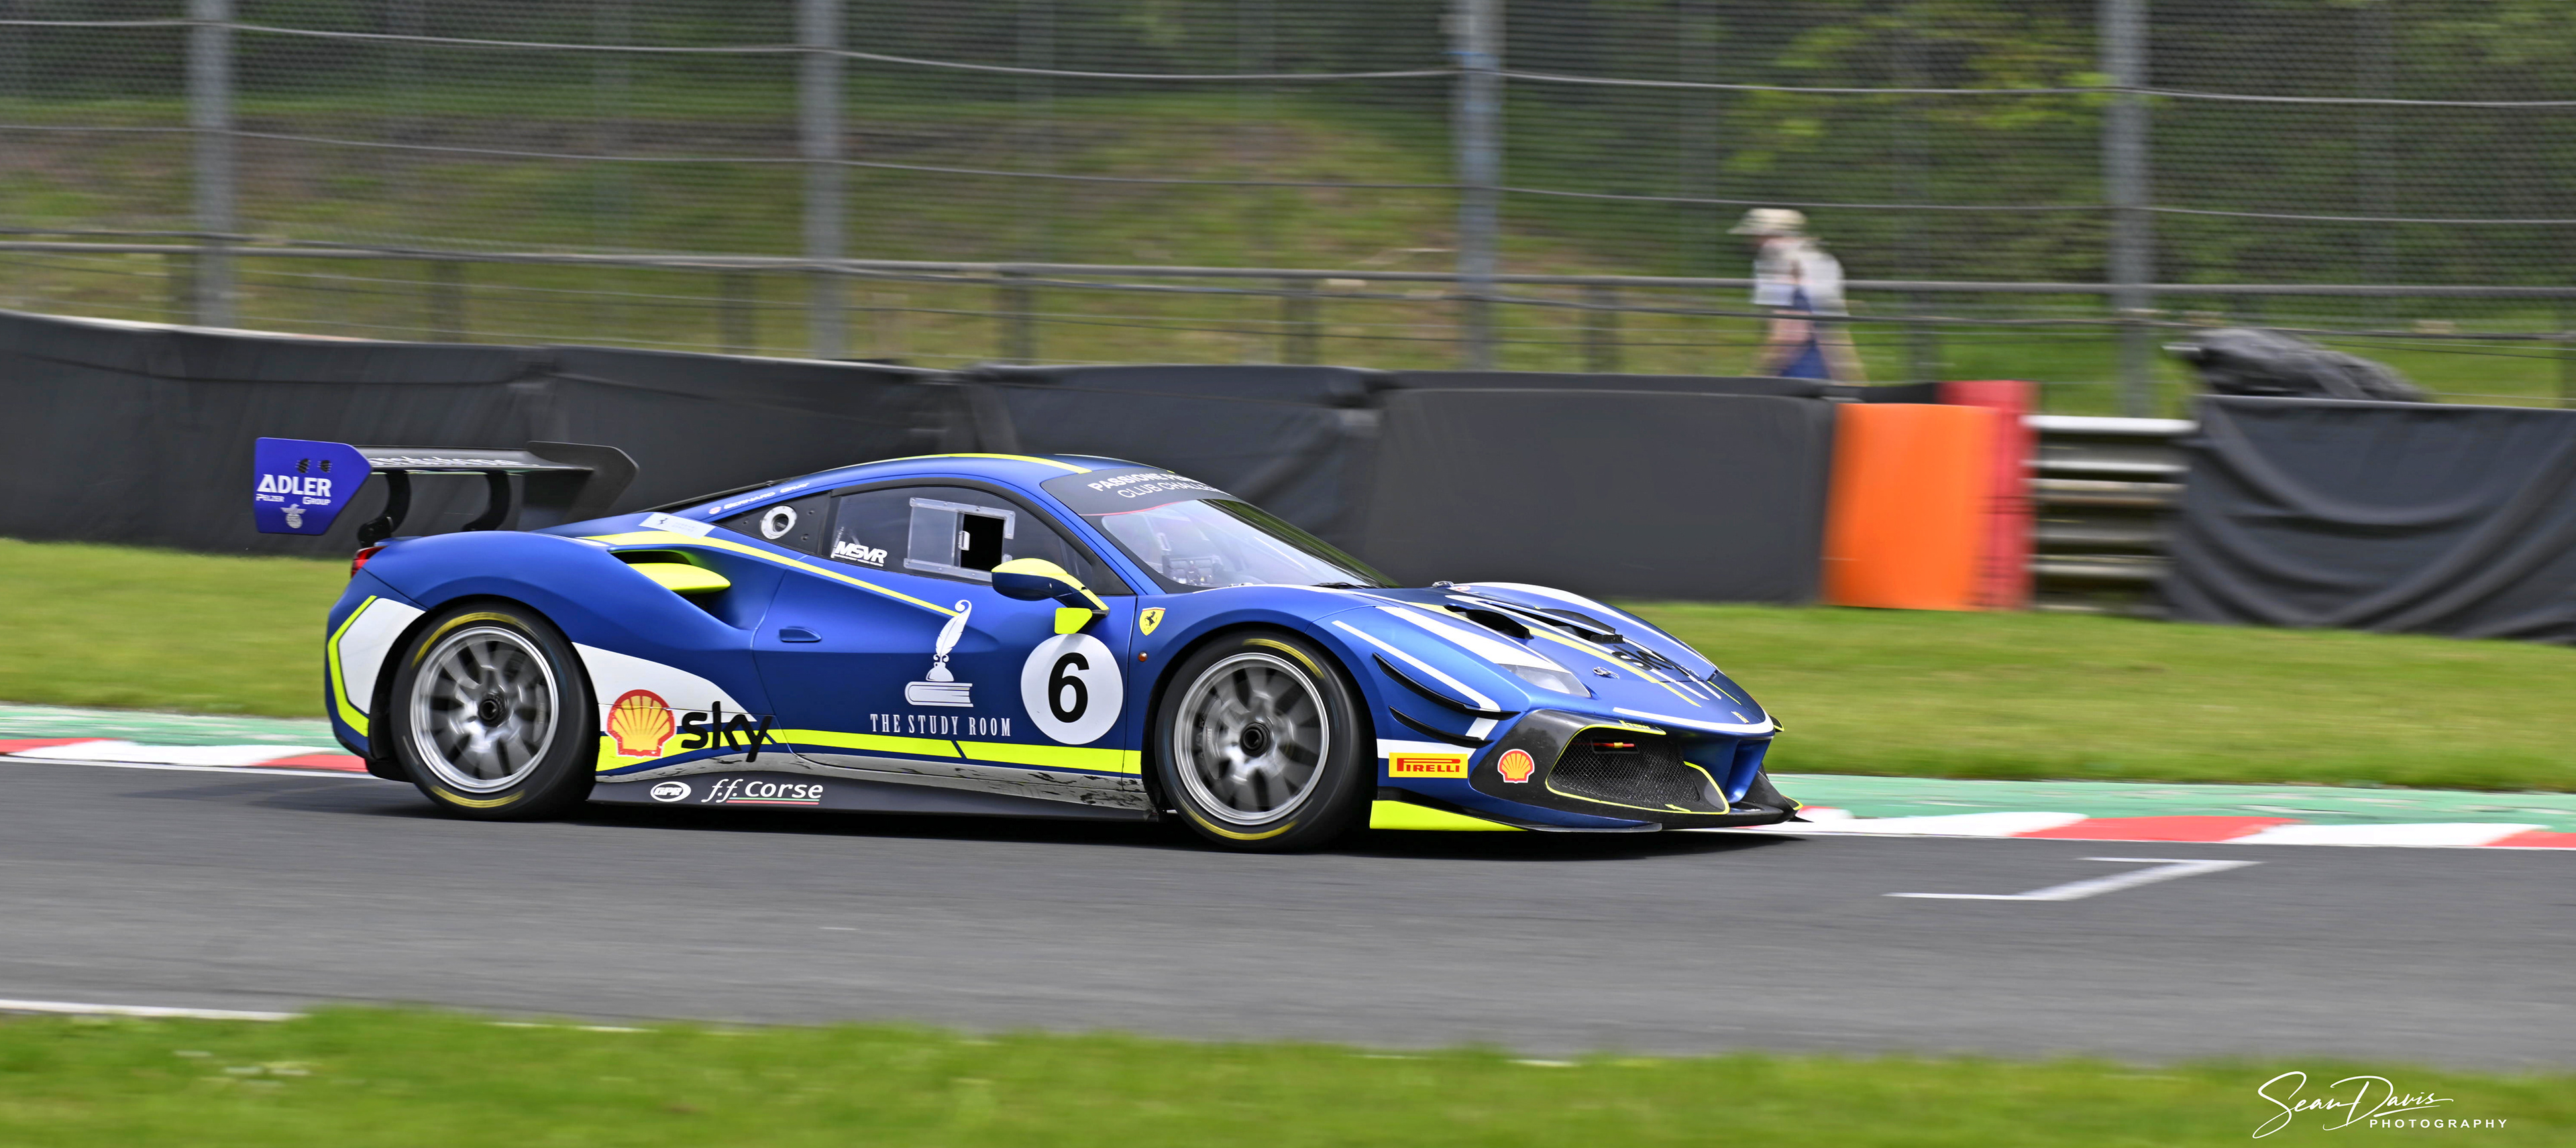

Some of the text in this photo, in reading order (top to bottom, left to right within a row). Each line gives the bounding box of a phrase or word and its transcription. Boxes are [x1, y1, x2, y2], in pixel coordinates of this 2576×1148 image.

[256, 474, 331, 497] ADLER
[1087, 473, 1169, 492] PASSIONE
[1117, 484, 1163, 498] CLUB
[834, 540, 888, 564] MSVR
[1048, 652, 1089, 723] 6
[682, 701, 773, 762] sky
[870, 713, 1011, 736] THE STUDY ROOM
[1397, 758, 1460, 772] PIRELLI
[653, 787, 684, 796] GPR
[745, 781, 823, 799] Corse
